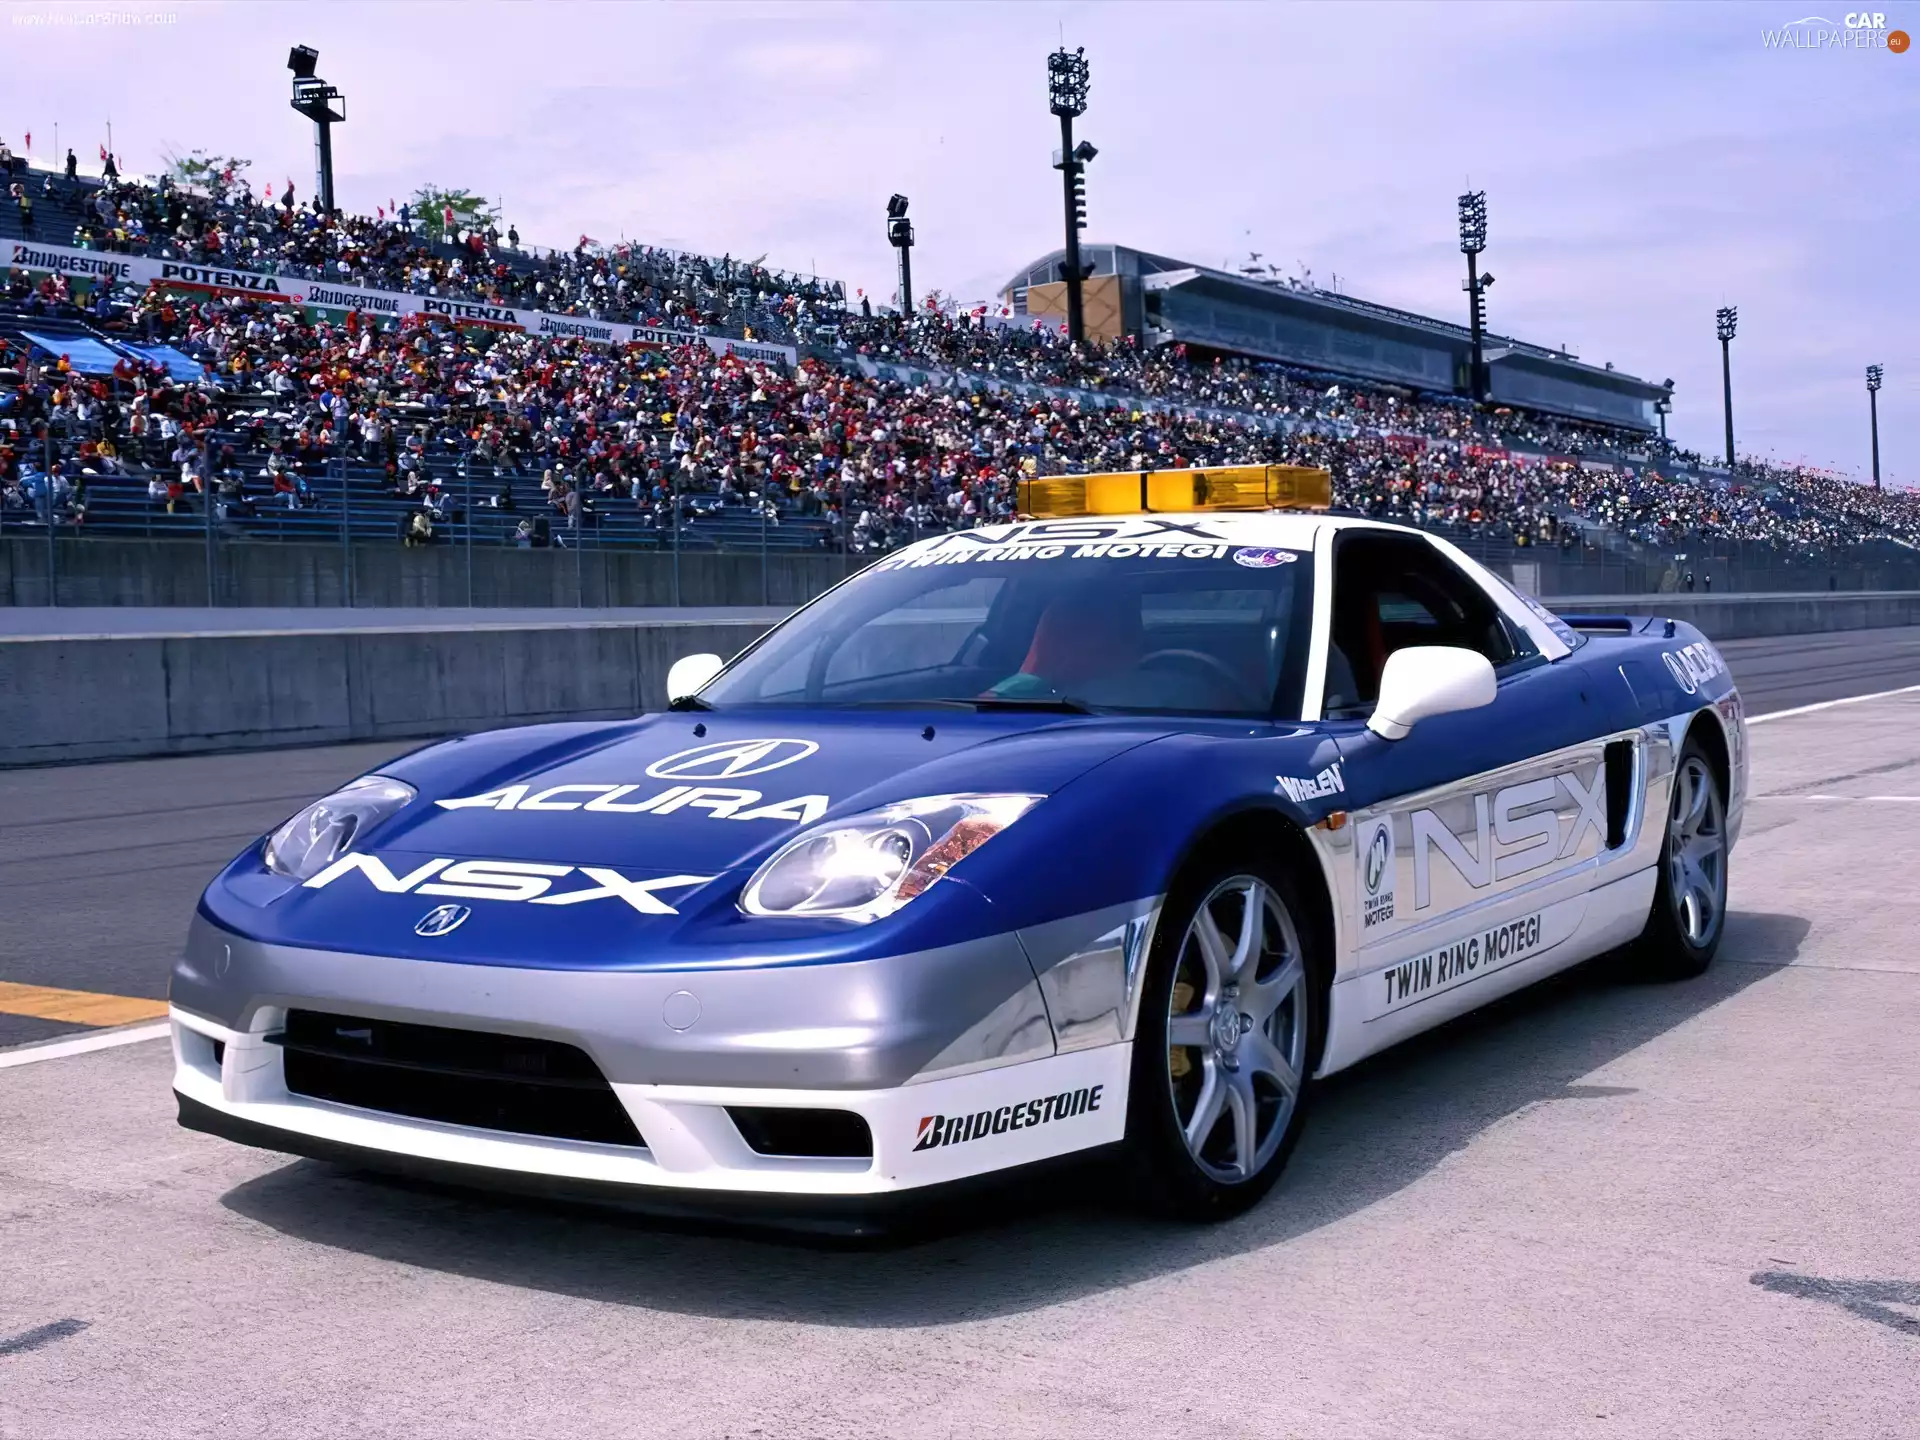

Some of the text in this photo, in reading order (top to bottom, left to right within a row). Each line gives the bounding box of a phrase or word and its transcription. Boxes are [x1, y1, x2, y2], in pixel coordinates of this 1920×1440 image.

[12, 245, 131, 278] BRIDGESTONE
[162, 263, 280, 292] POTENZA
[308, 285, 399, 312] BRIDGESTONE
[423, 299, 517, 323] POTENZA
[632, 328, 706, 347] POTENZA
[929, 520, 1239, 551] NSX
[888, 550, 976, 570] TWIN
[976, 546, 1066, 562] RING
[1072, 543, 1229, 559] MOTEGI
[1275, 762, 1345, 803] WHELEN
[434, 784, 829, 824] ACURA
[1409, 762, 1607, 911] NSX
[302, 852, 717, 915] NSX
[1364, 905, 1394, 928] MOTEGI
[1384, 914, 1541, 1004] TWIN RING MOTEGI
[912, 1084, 1104, 1152] BRIDGESTONE
